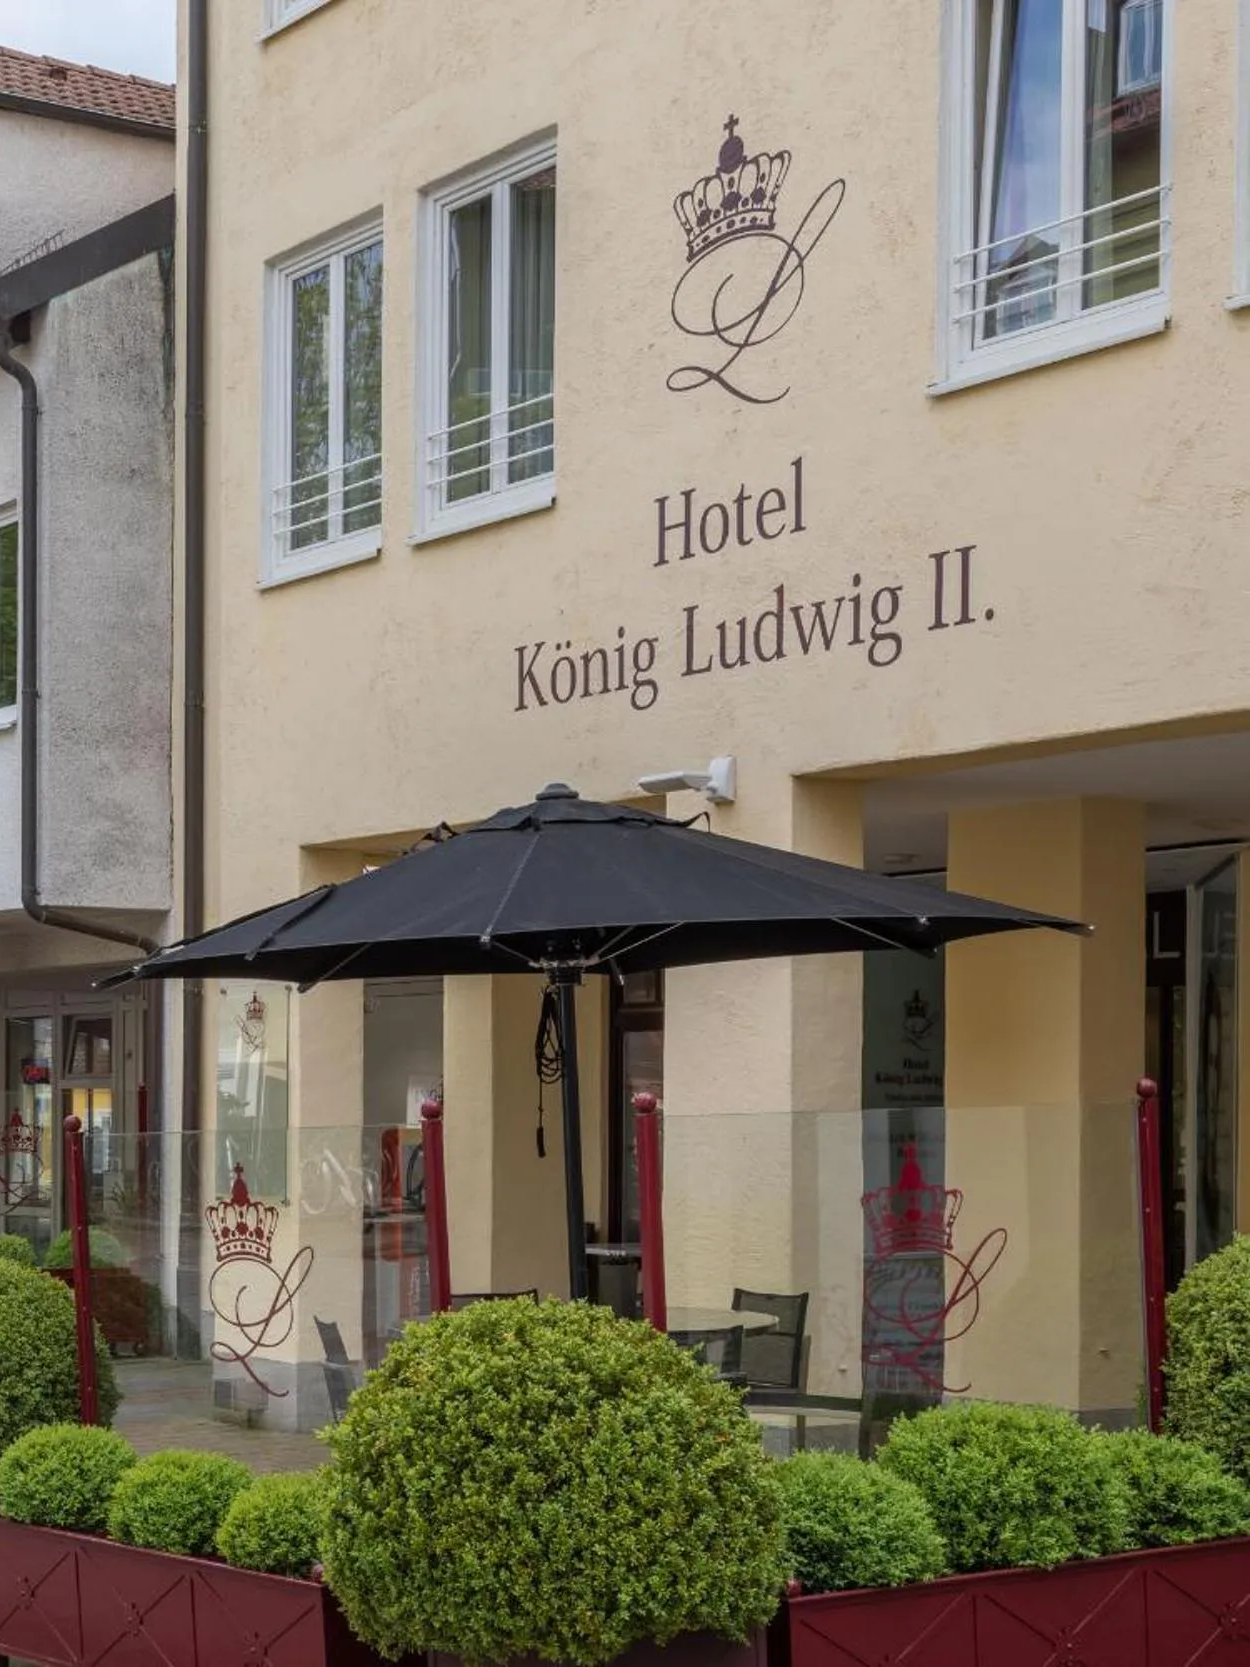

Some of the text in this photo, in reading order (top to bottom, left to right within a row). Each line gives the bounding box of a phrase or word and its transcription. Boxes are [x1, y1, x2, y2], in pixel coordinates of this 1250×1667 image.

[653, 456, 807, 567] Hotel
[513, 544, 996, 711] König Ludwig II.
